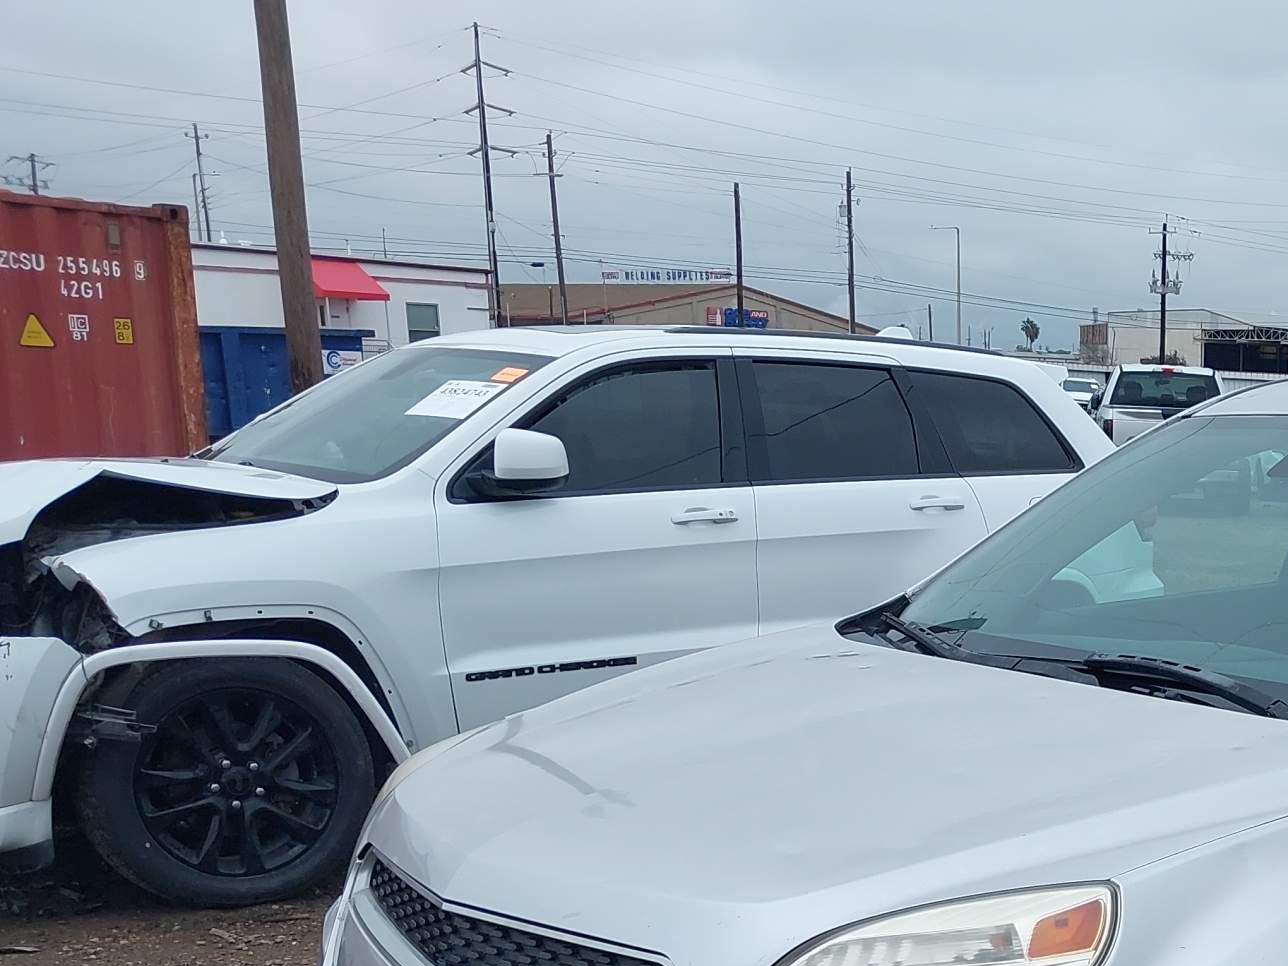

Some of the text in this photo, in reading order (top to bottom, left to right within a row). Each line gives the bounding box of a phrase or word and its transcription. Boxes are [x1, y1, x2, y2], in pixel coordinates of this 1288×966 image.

[0, 250, 145, 279] ZCSU 255496 9
[625, 271, 661, 281] WELDING
[666, 270, 710, 281] SUPPLIES
[60, 280, 103, 300] 42G1
[73, 331, 88, 341] 81
[465, 656, 638, 682] GRAND CHEROKEE
